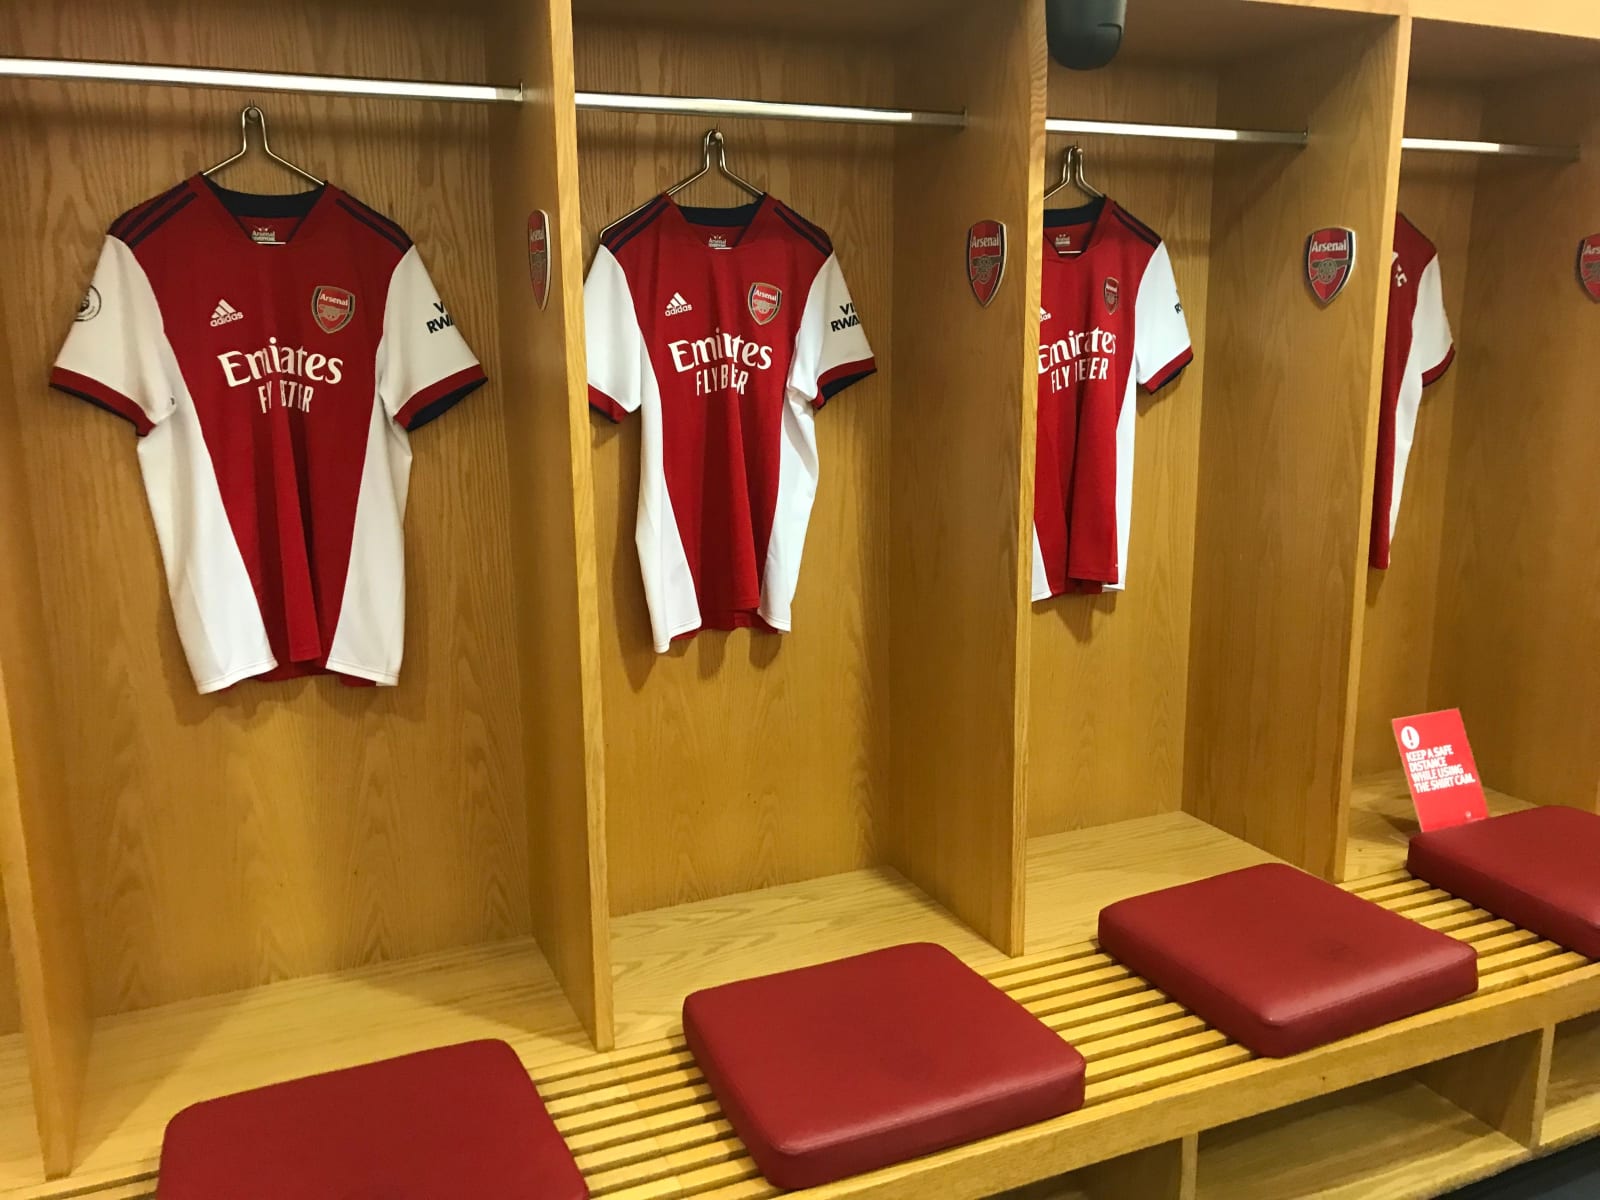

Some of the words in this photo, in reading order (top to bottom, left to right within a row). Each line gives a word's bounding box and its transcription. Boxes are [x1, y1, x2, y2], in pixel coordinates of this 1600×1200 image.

[972, 233, 999, 248] Arsenal
[1312, 239, 1347, 252] Arsenal
[319, 293, 349, 307] Arsenal
[755, 289, 777, 301] Arsenal
[665, 304, 693, 317] adidas
[210, 311, 244, 327] adidas
[216, 336, 344, 388] Emiates
[1051, 365, 1071, 394] FLY
[1405, 749, 1427, 762] KEEP
[1427, 748, 1435, 759] A
[1433, 744, 1454, 757] SAFE
[1408, 756, 1448, 772] DISTANCE
[1411, 769, 1438, 783] WHILE
[1438, 764, 1464, 778] USING
[1414, 780, 1432, 793] THE
